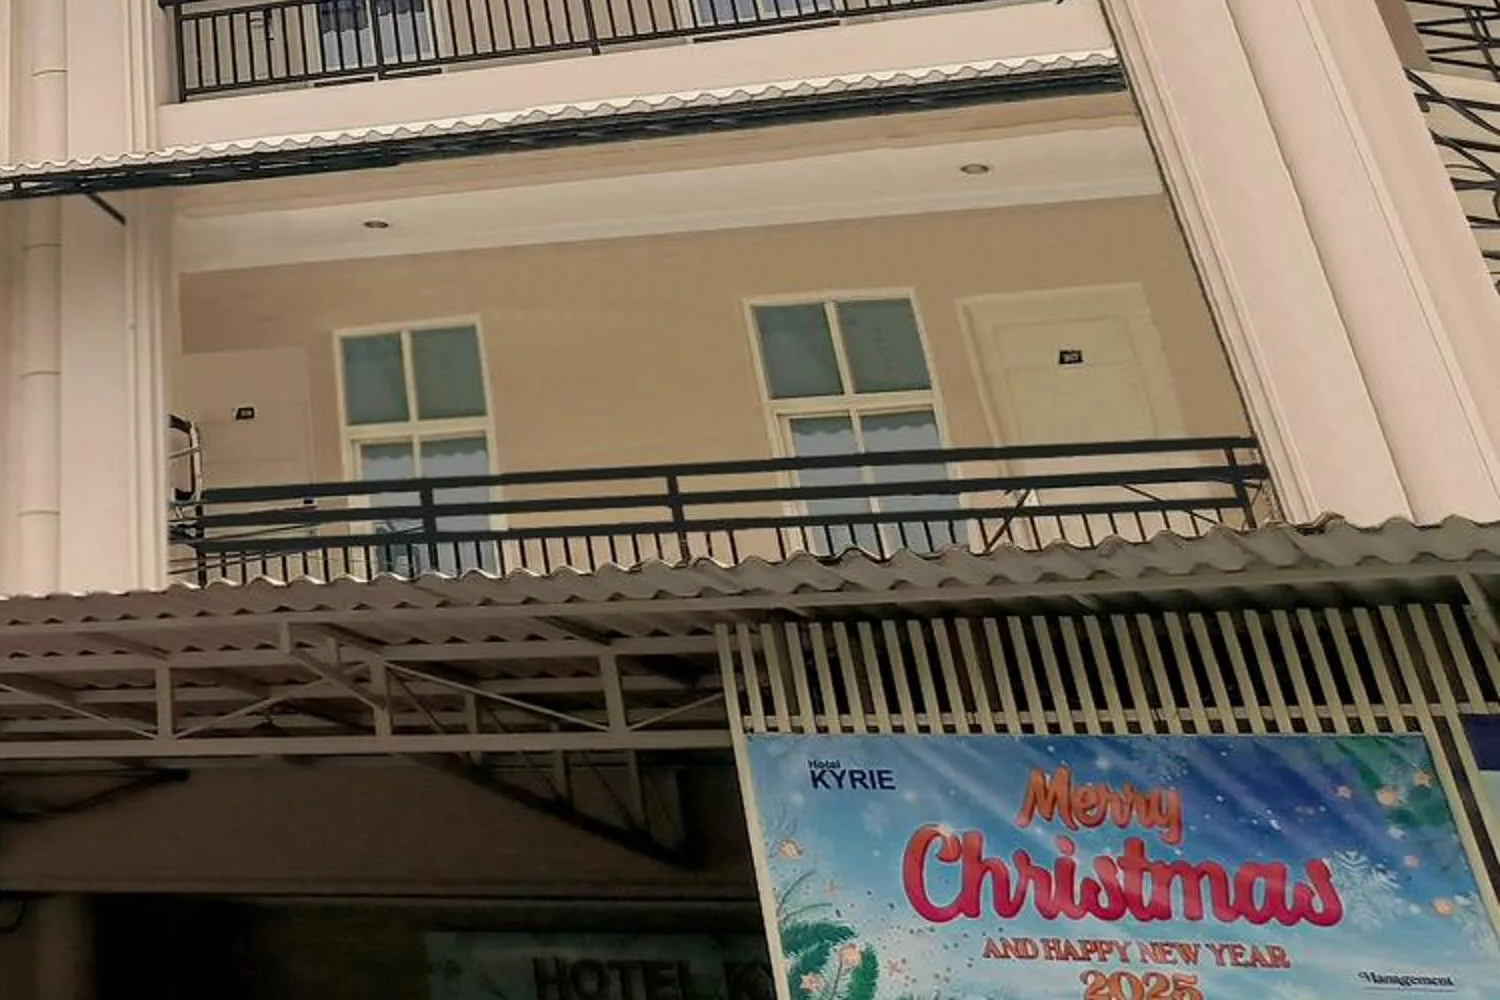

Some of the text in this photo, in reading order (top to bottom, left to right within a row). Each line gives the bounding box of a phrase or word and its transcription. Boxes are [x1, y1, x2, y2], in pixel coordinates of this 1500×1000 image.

[807, 759, 841, 769] Hotel
[810, 769, 896, 790] KYRIE
[1016, 766, 1184, 845] Merry
[902, 824, 1345, 927] Christmas
[982, 937, 1291, 968] AND HAPPY NEW YEAR
[1080, 969, 1203, 1000] 2025
